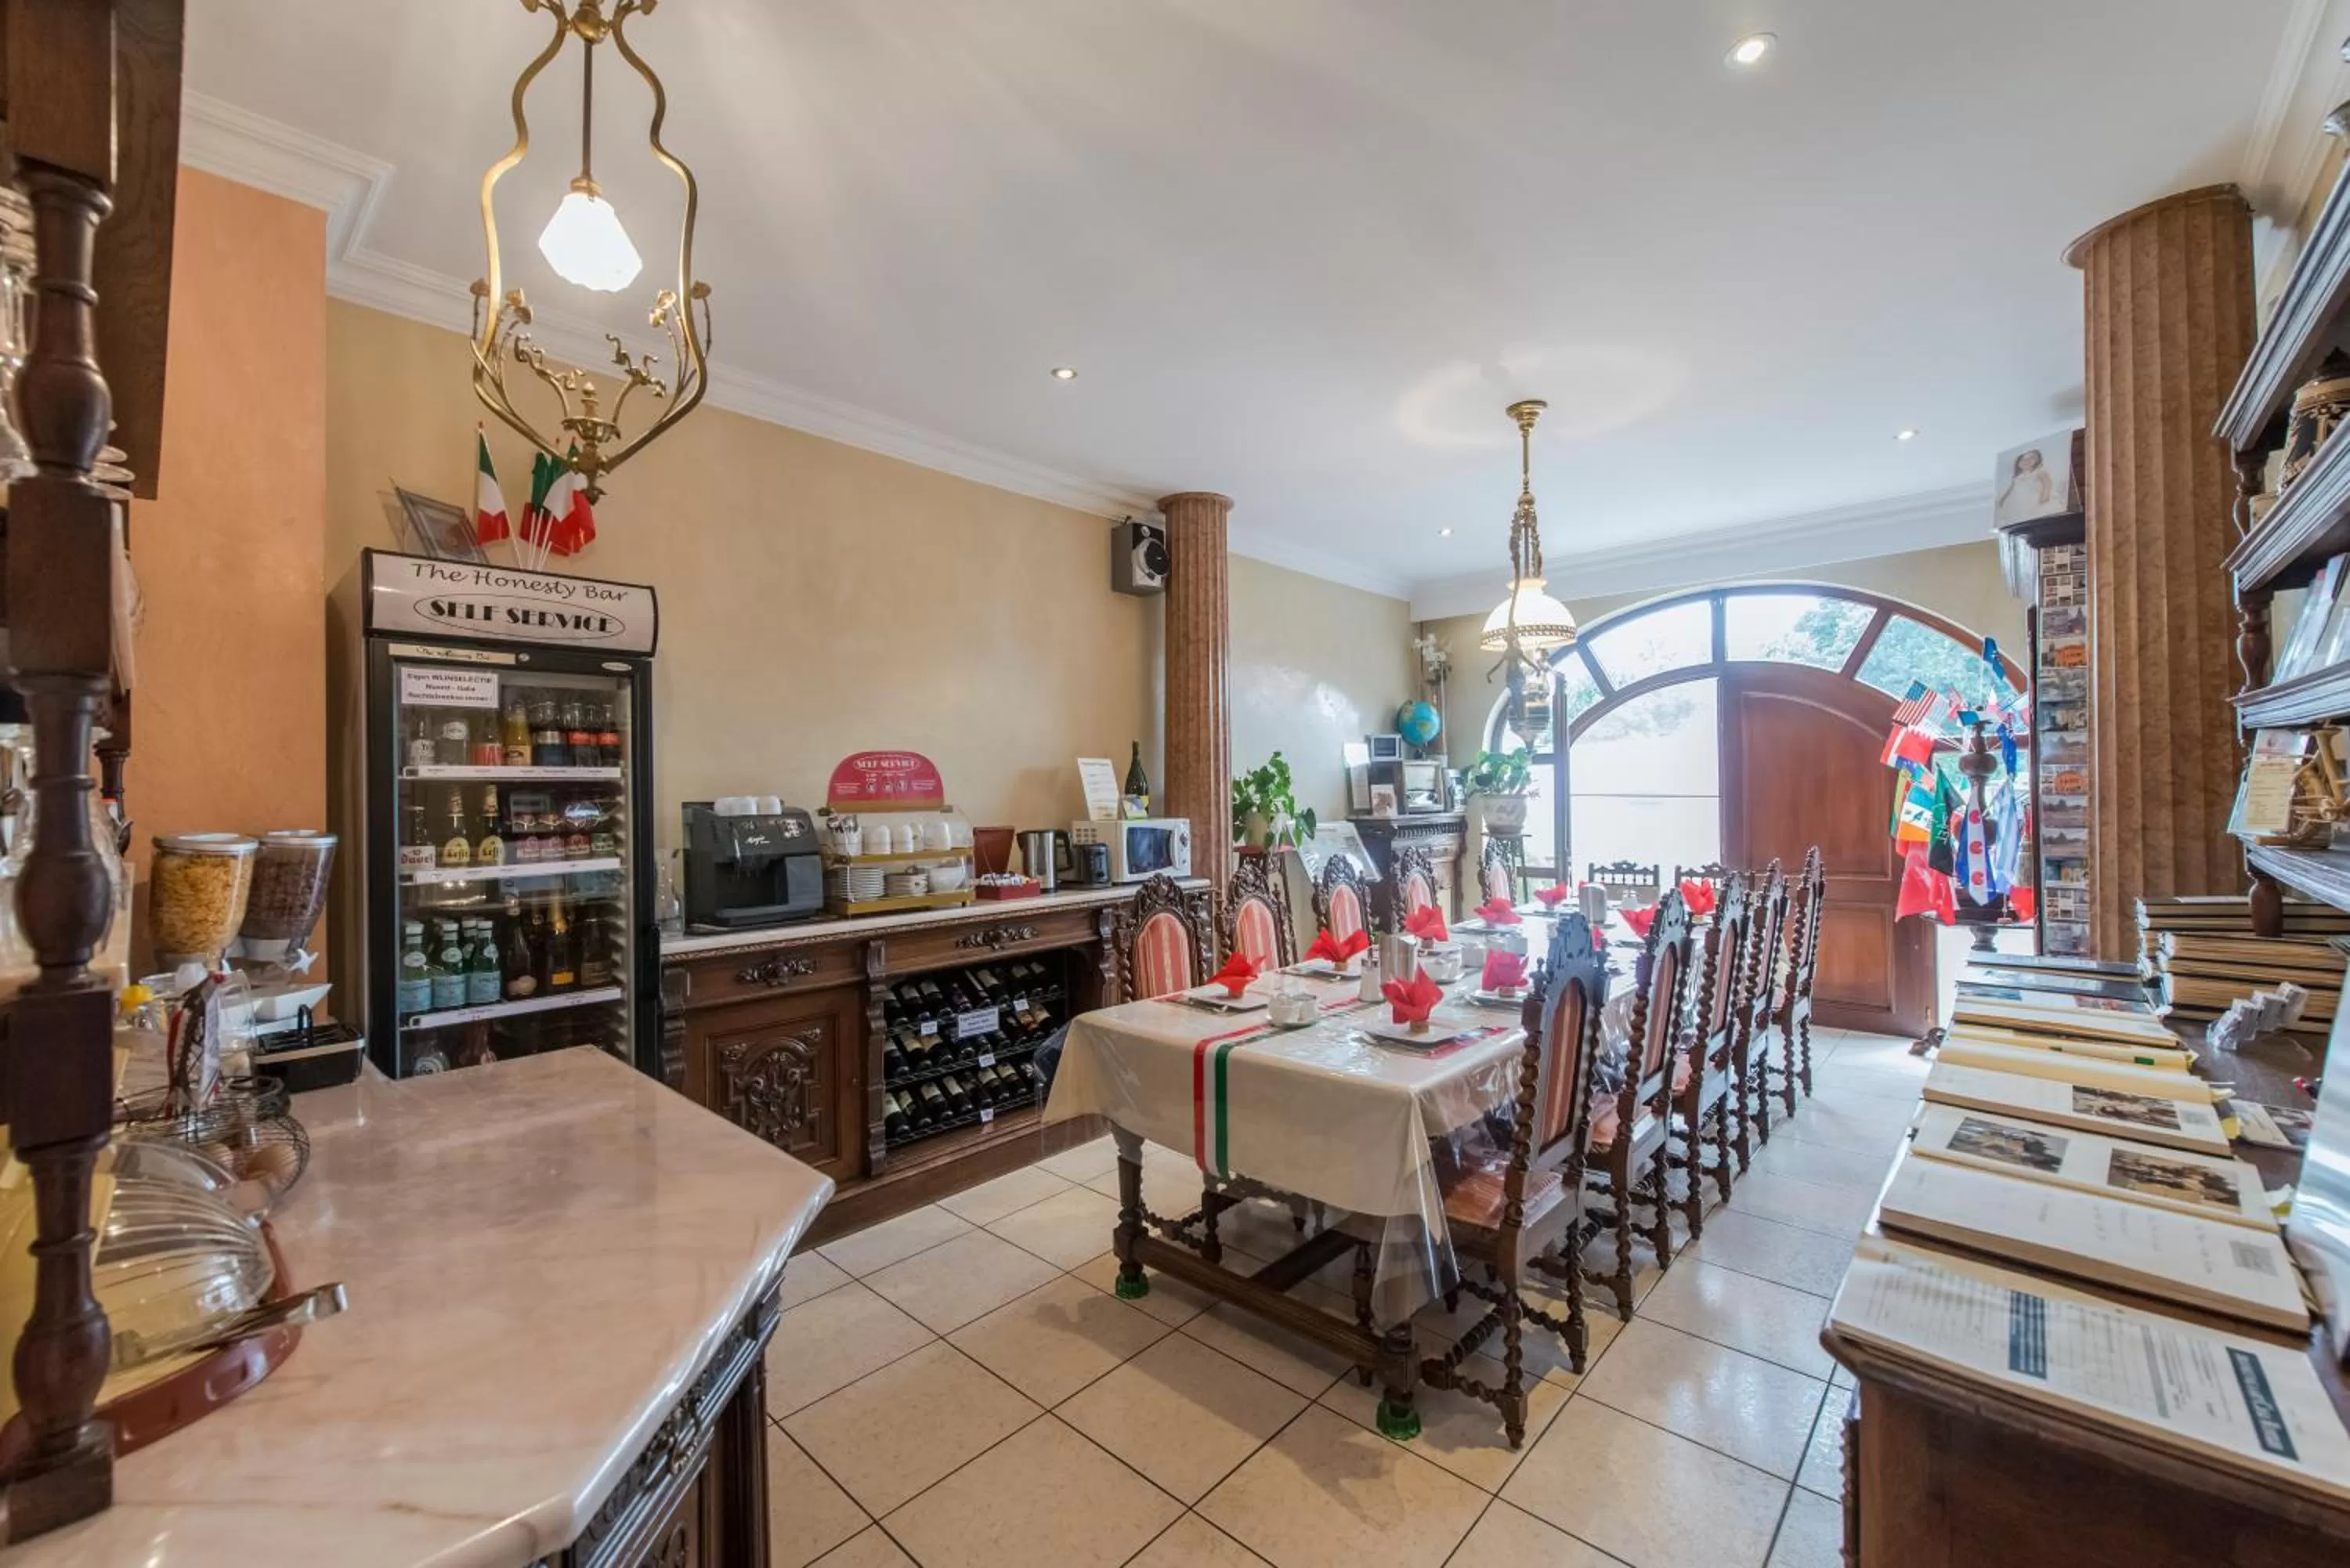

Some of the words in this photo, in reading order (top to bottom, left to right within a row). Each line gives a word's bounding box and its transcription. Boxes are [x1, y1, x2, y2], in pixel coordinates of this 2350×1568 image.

[410, 563, 468, 582] The
[473, 569, 576, 599] Honesty
[583, 585, 629, 602] Bar
[430, 599, 501, 621] SELF
[504, 607, 613, 633] SERVICE
